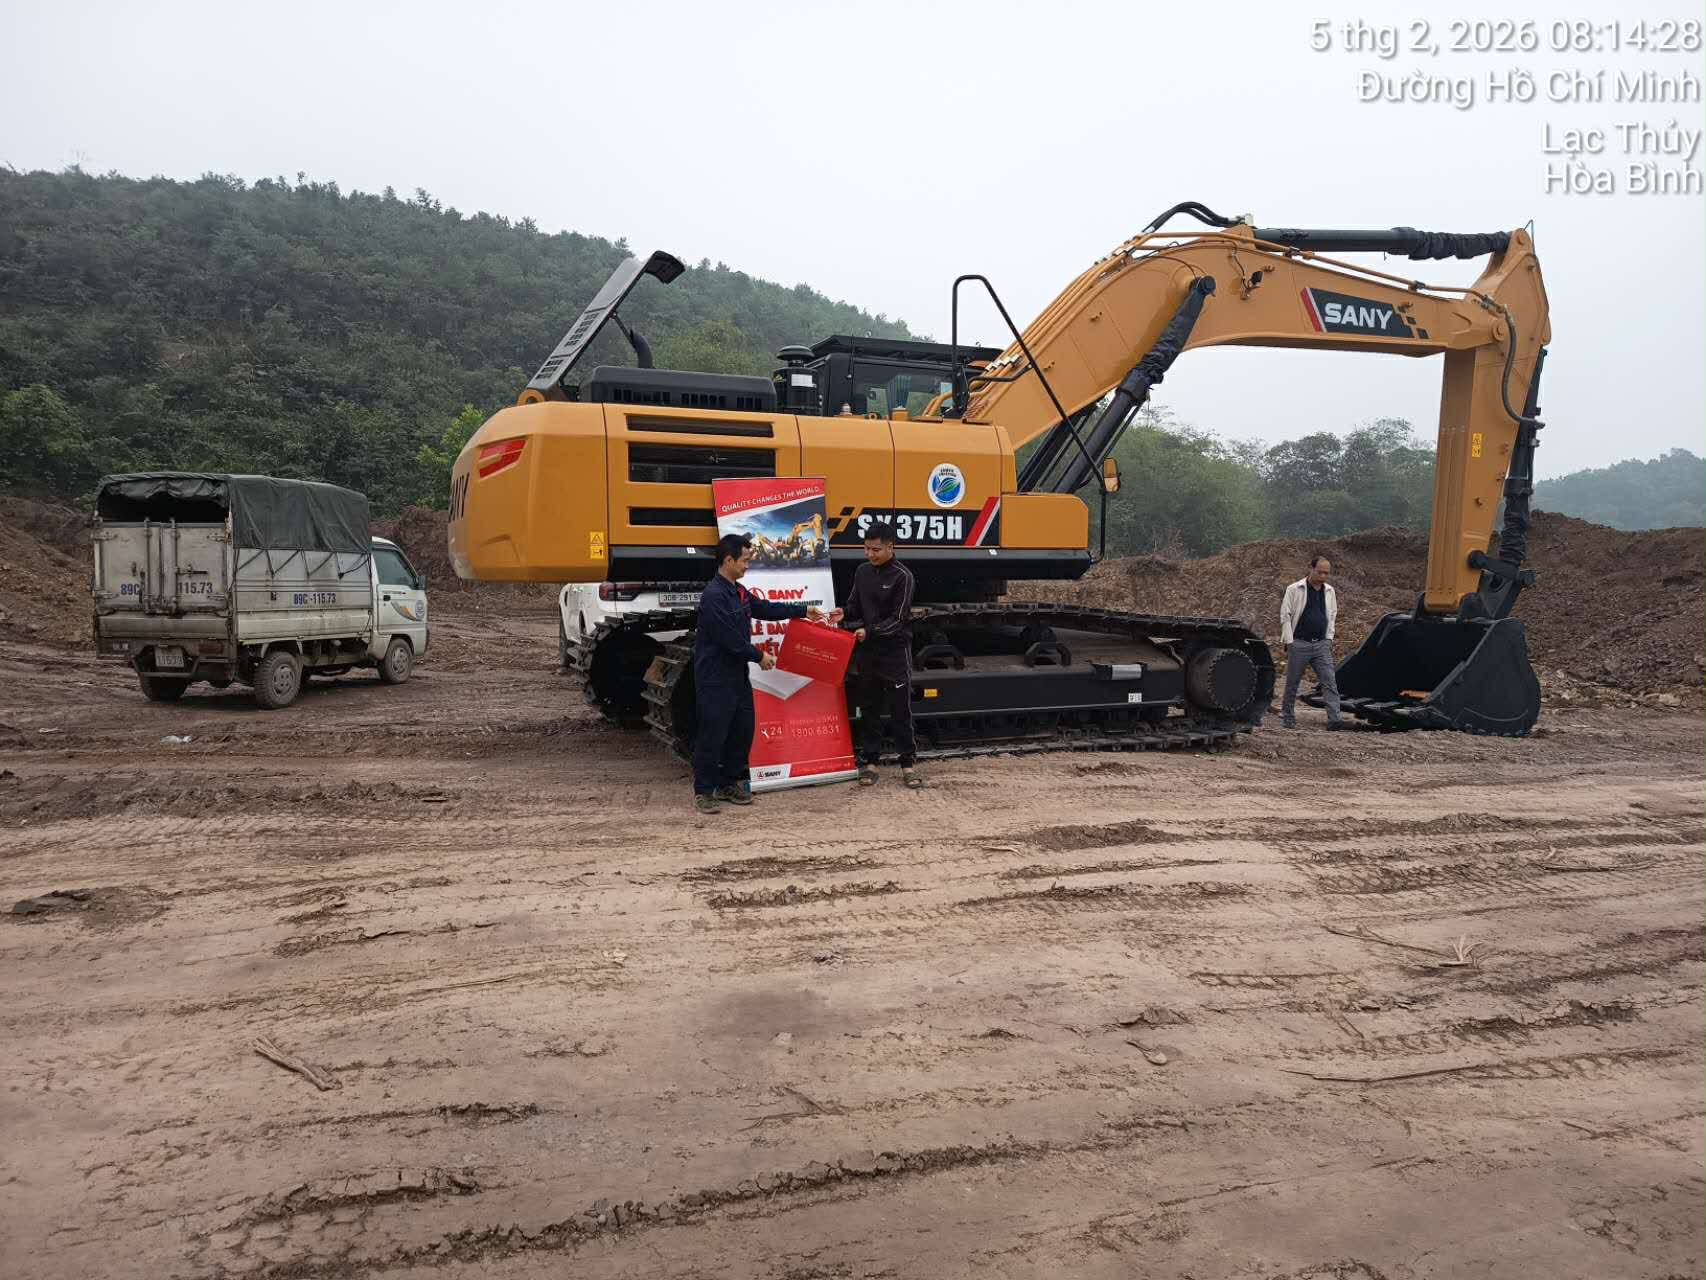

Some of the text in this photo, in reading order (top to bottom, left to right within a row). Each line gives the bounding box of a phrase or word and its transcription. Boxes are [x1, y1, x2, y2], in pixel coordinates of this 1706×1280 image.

[1324, 302, 1393, 330] SANY
[721, 485, 819, 512] QUALITY CHANGES THE WORLD
[120, 583, 141, 595] 89C
[767, 589, 804, 600] SANY
[769, 726, 783, 736] 24
[764, 770, 782, 778] SANY
